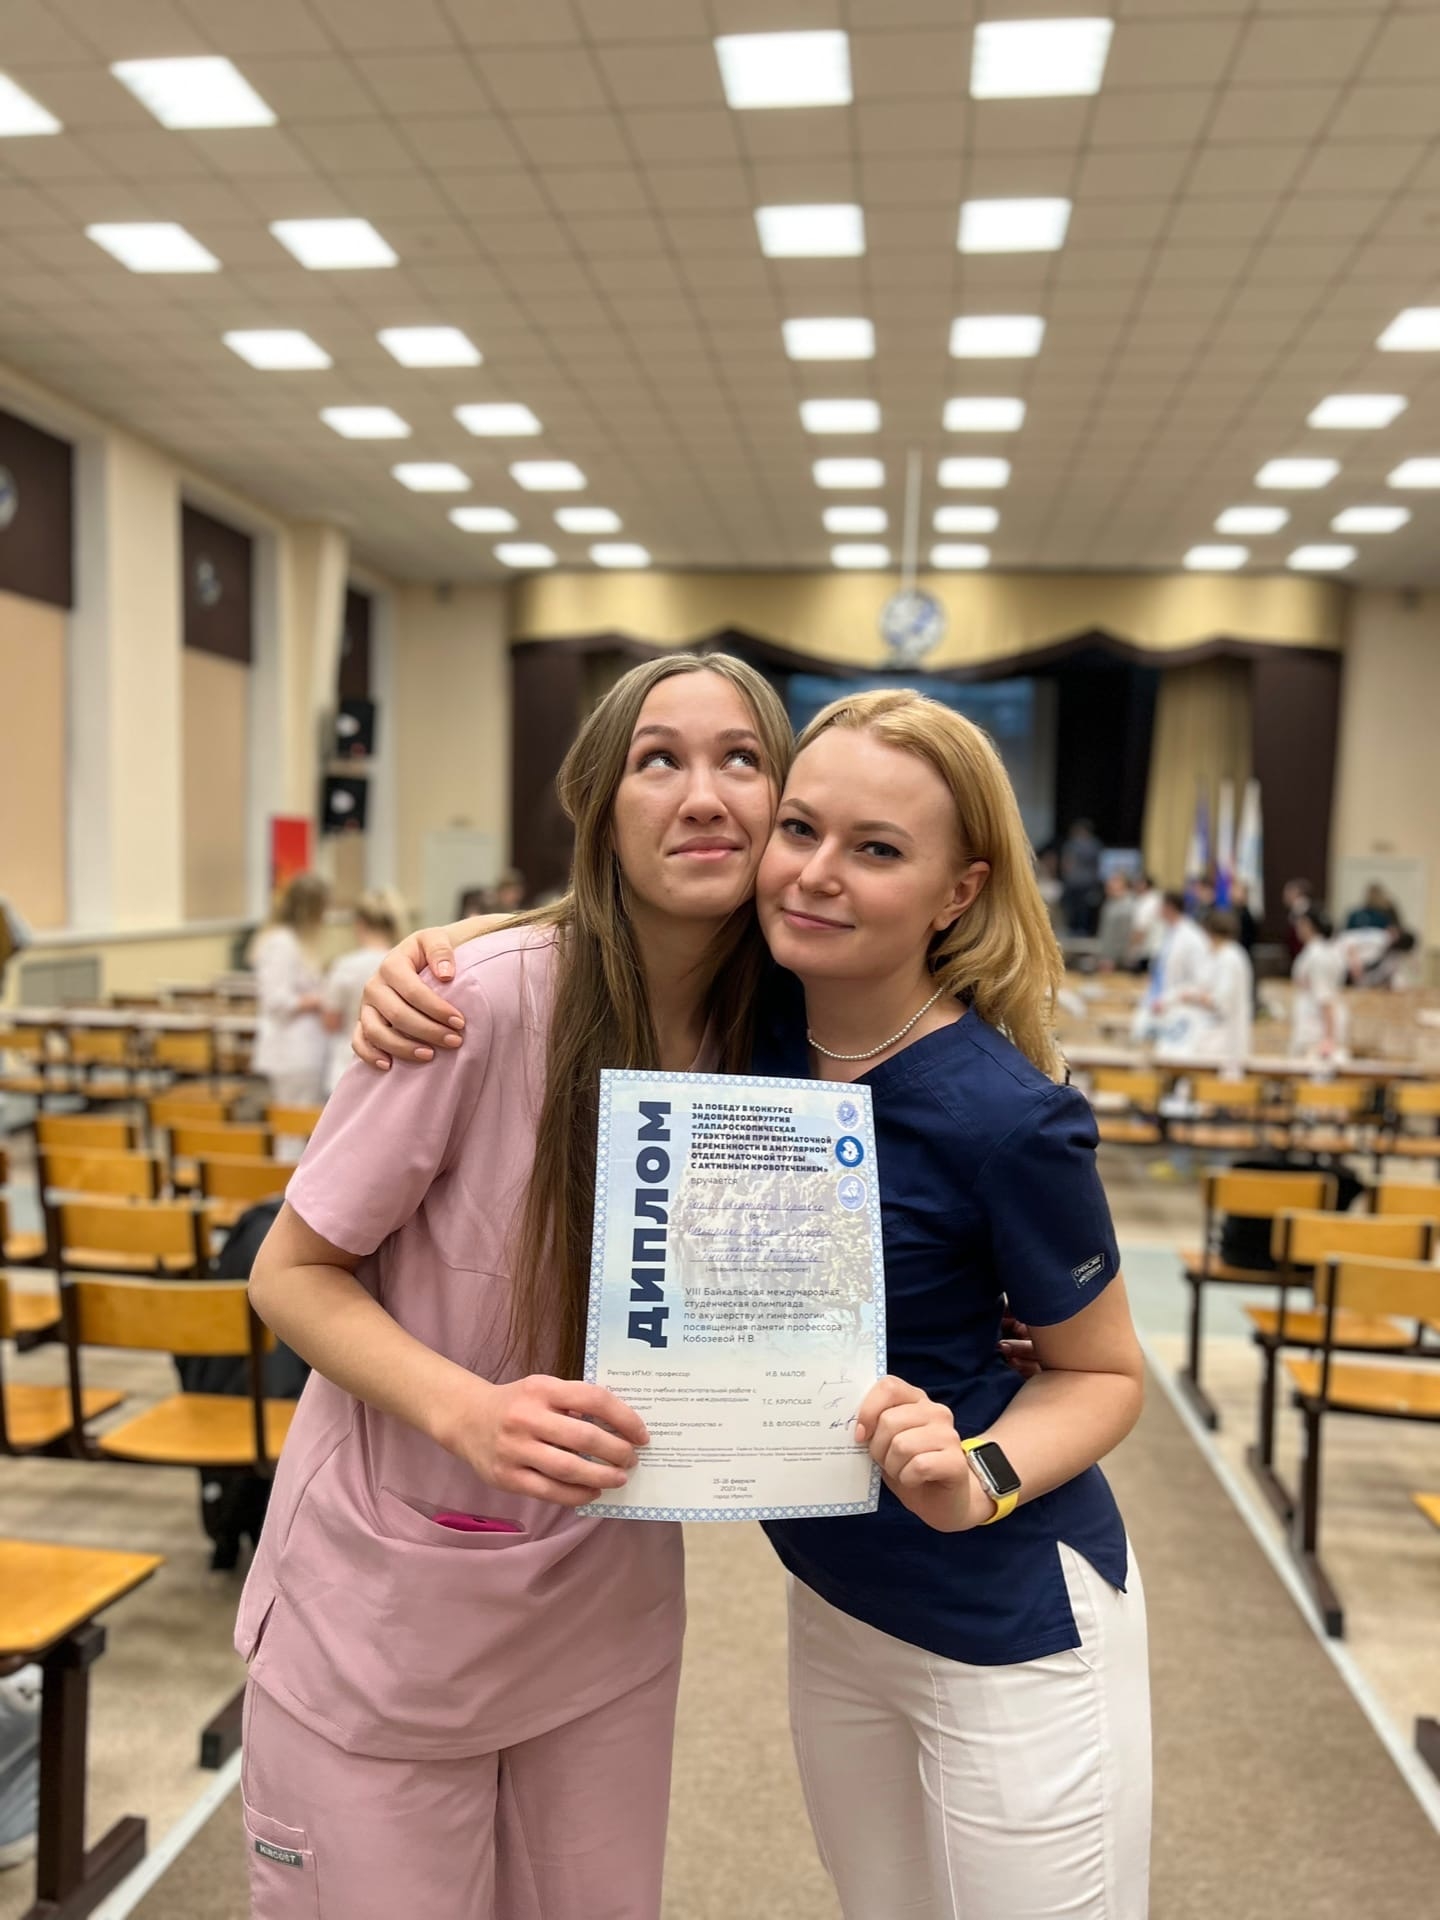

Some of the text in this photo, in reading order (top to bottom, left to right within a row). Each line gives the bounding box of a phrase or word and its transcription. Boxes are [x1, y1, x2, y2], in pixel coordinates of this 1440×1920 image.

[705, 1103, 740, 1112] ПОБЕДУ
[749, 1105, 793, 1114] КОНКУРСЕ
[692, 1113, 791, 1123] ЭНДОВИДЕОХИРУРГИЯ
[692, 1123, 796, 1133] «ЛАПАРОСКОПИЧЕСКАЯ
[692, 1132, 750, 1141] ТУБЭКТОМИЯ
[771, 1135, 832, 1144] ВНЕМАТОЧНОЙ
[691, 1142, 760, 1151] БЕРЕМЕННОСТИ
[769, 1145, 827, 1153] АМПУЛЯРНОМ
[691, 1152, 726, 1160] ОТДЕЛЕ
[728, 1152, 775, 1161] МАТОЧНОЙ
[698, 1162, 749, 1170] АКТИВНЫМ
[751, 1163, 829, 1173] КРОВОТЕЧЕНИЕМ»
[691, 1177, 737, 1185] вручается
[627, 1100, 671, 1348] ДИПЛОМ
[686, 1287, 840, 1298] VIII Байкальская международная
[684, 1301, 749, 1309] студенческая
[698, 1312, 755, 1321] акушерству
[787, 1323, 842, 1333] профессора
[683, 1334, 735, 1343] Кобозевой
